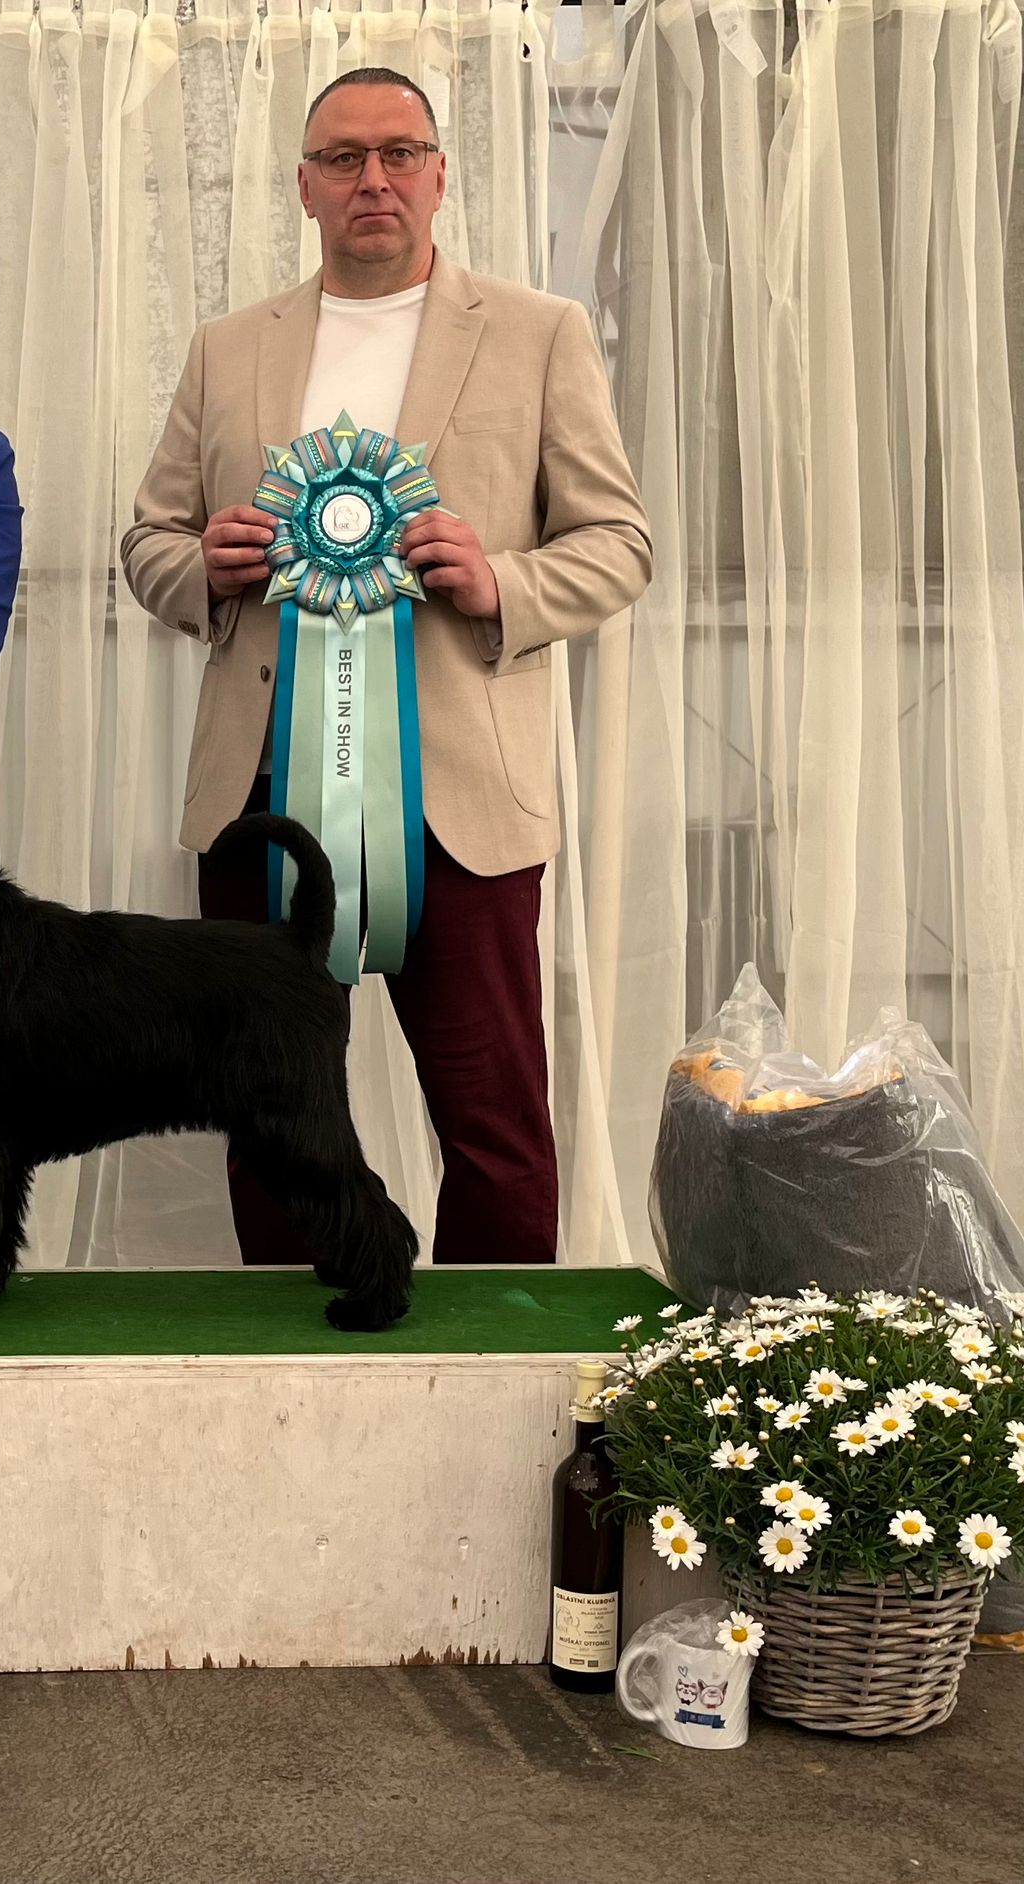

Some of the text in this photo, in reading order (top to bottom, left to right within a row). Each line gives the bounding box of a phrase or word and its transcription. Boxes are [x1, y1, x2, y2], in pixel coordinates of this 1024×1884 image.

[336, 648, 353, 778] BEST IN SHOW
